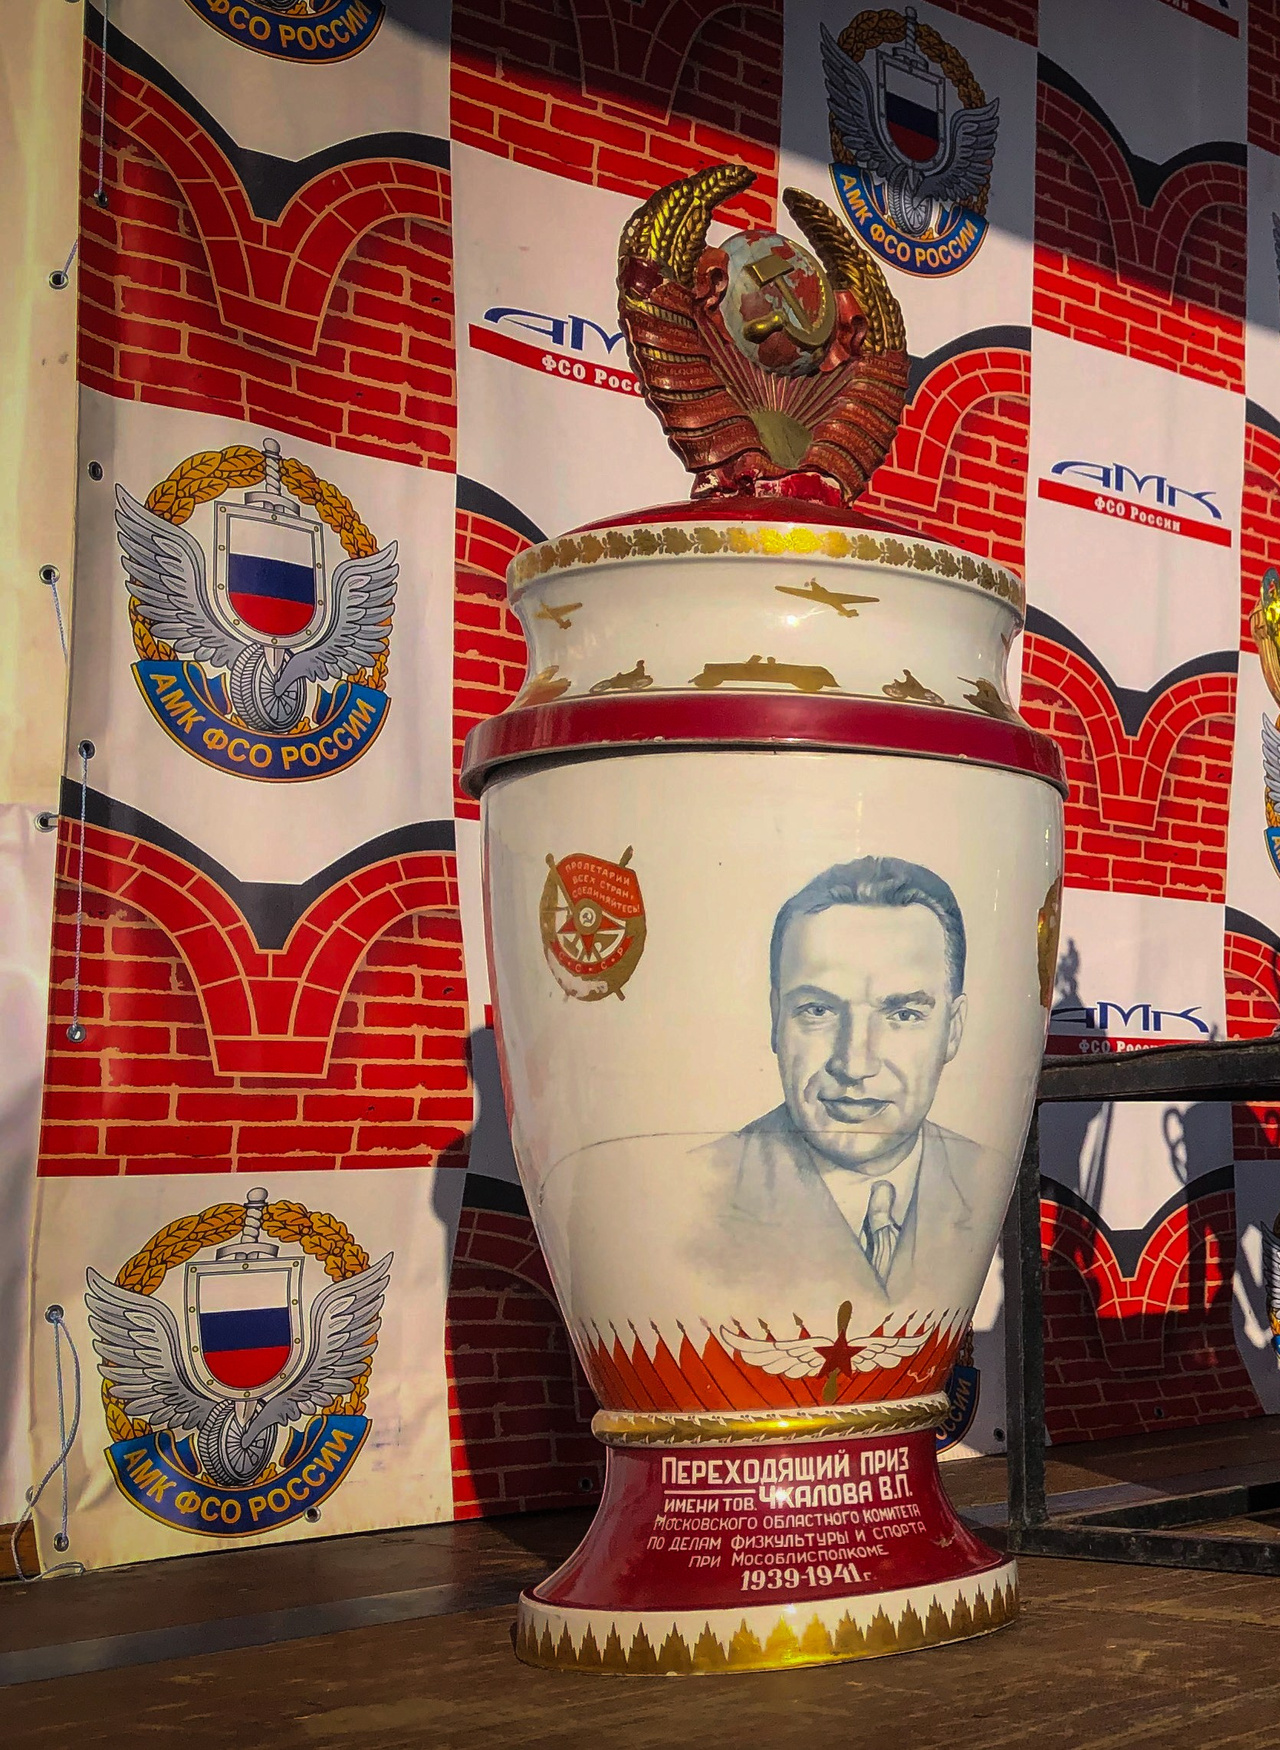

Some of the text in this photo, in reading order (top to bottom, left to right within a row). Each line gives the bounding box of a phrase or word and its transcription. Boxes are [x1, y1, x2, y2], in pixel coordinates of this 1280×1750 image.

[278, 0, 373, 50] РОССИИ
[839, 174, 979, 267] АМК ФСО РОССИИ
[542, 354, 586, 380] ФСО
[594, 367, 641, 392] Росс
[1051, 461, 1222, 520] АМК
[1094, 496, 1181, 532] ФСО России
[149, 673, 377, 770] АМК ФСО РОССИИ
[565, 861, 631, 887] ПРОЛЕТАРИИ
[572, 874, 596, 886] ВСЕХ
[1051, 1002, 1209, 1033] АМК
[1079, 1039, 1110, 1053] ФСО
[124, 1428, 354, 1524] АМК ФСО РОССИИ
[860, 1446, 909, 1476] ПРИЗ
[664, 1499, 718, 1513] ИМЕНИ
[722, 1497, 757, 1512] ТОВ.
[880, 1474, 913, 1500] В.П.
[762, 1511, 860, 1530] ОБЛАСТНОГО
[863, 1503, 921, 1524] КОМИТЕТА
[647, 1520, 927, 1552] ПО ДЕЛАМ ФИЗКУЛЬТУРЫ И СПОРТА
[688, 1555, 721, 1568] ПРИ
